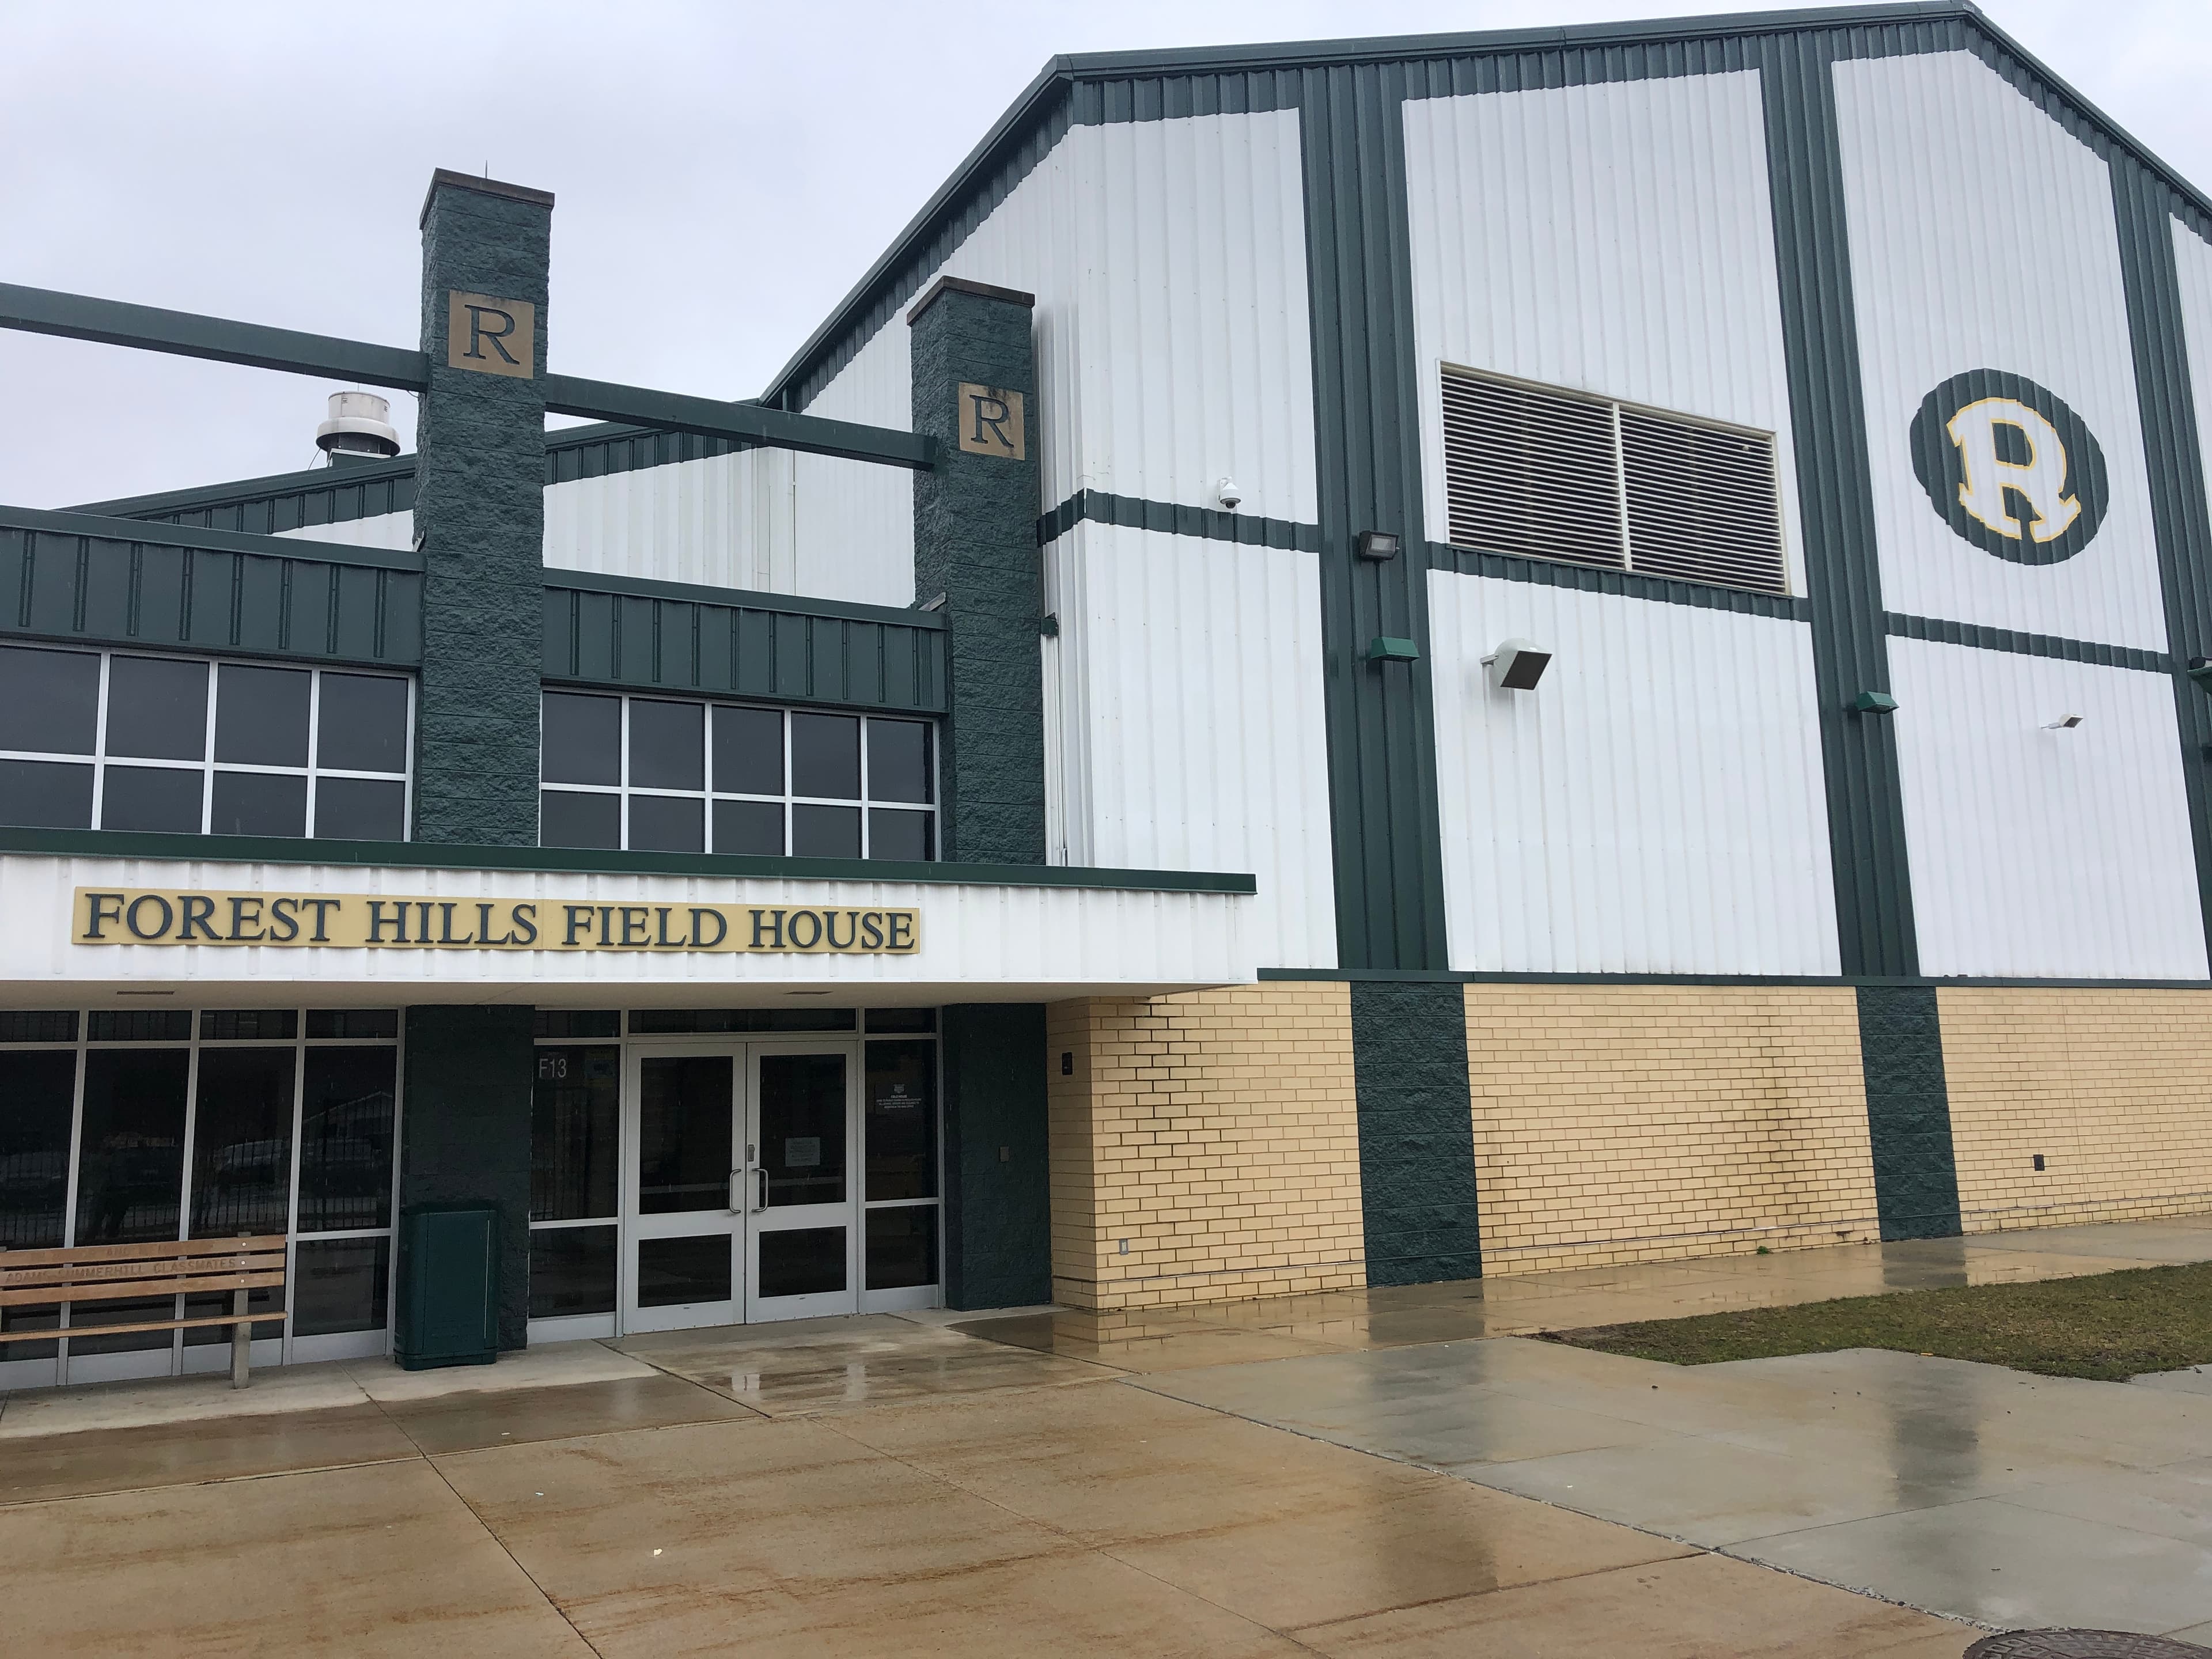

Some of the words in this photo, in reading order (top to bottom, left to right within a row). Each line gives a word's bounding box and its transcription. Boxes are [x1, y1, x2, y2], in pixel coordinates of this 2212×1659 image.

[463, 304, 520, 365] R
[969, 395, 1014, 448] R
[1946, 397, 2081, 543] R
[82, 893, 340, 942] FOREST
[365, 900, 537, 945] HILLS
[562, 905, 728, 948] FIELD
[748, 909, 915, 949] HOUSE
[539, 1058, 567, 1078] F13
[153, 1258, 236, 1274] CLASSMATES
